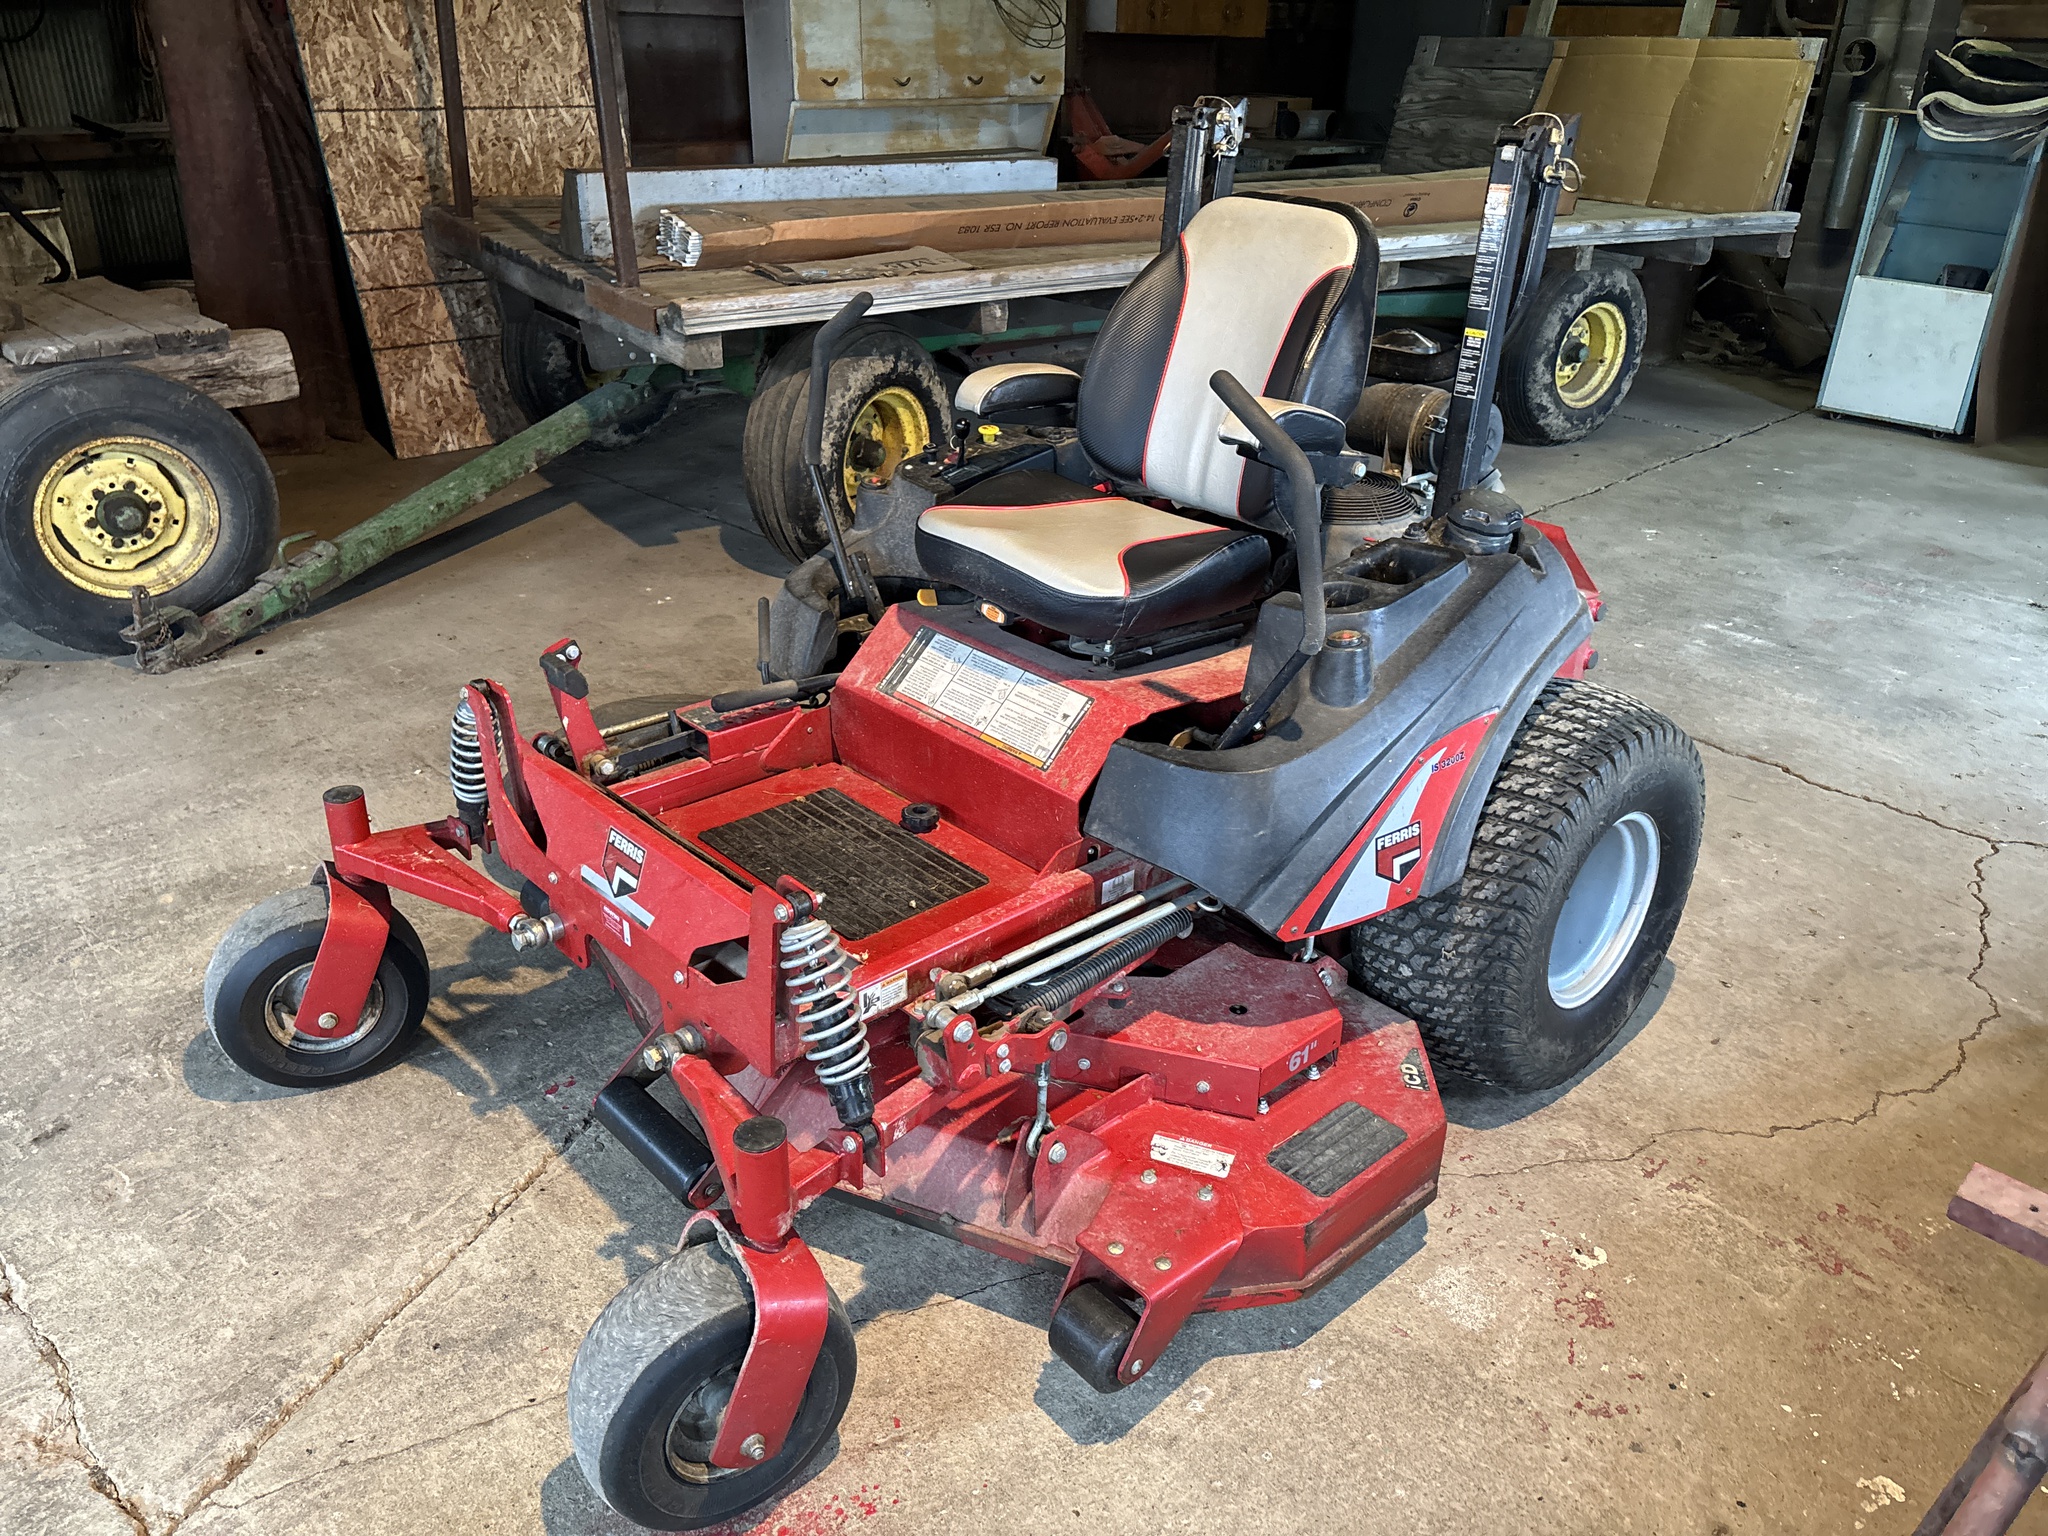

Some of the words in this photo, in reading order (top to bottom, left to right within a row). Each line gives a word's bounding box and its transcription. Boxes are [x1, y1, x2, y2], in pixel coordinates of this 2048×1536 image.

[983, 222, 1001, 233] ESR
[1005, 221, 1023, 232] NO.
[1024, 218, 1060, 231] REPORT
[1061, 215, 1118, 228] EVALUATION
[957, 222, 980, 235] 1083
[1431, 763, 1439, 773] IS
[1441, 751, 1465, 769] 3200Z
[1377, 823, 1420, 851] FERRIS
[608, 829, 645, 864] FERRIS
[1288, 1039, 1318, 1072] 61"
[1400, 1063, 1424, 1090] iCD
[1185, 1136, 1213, 1149] DANGER
